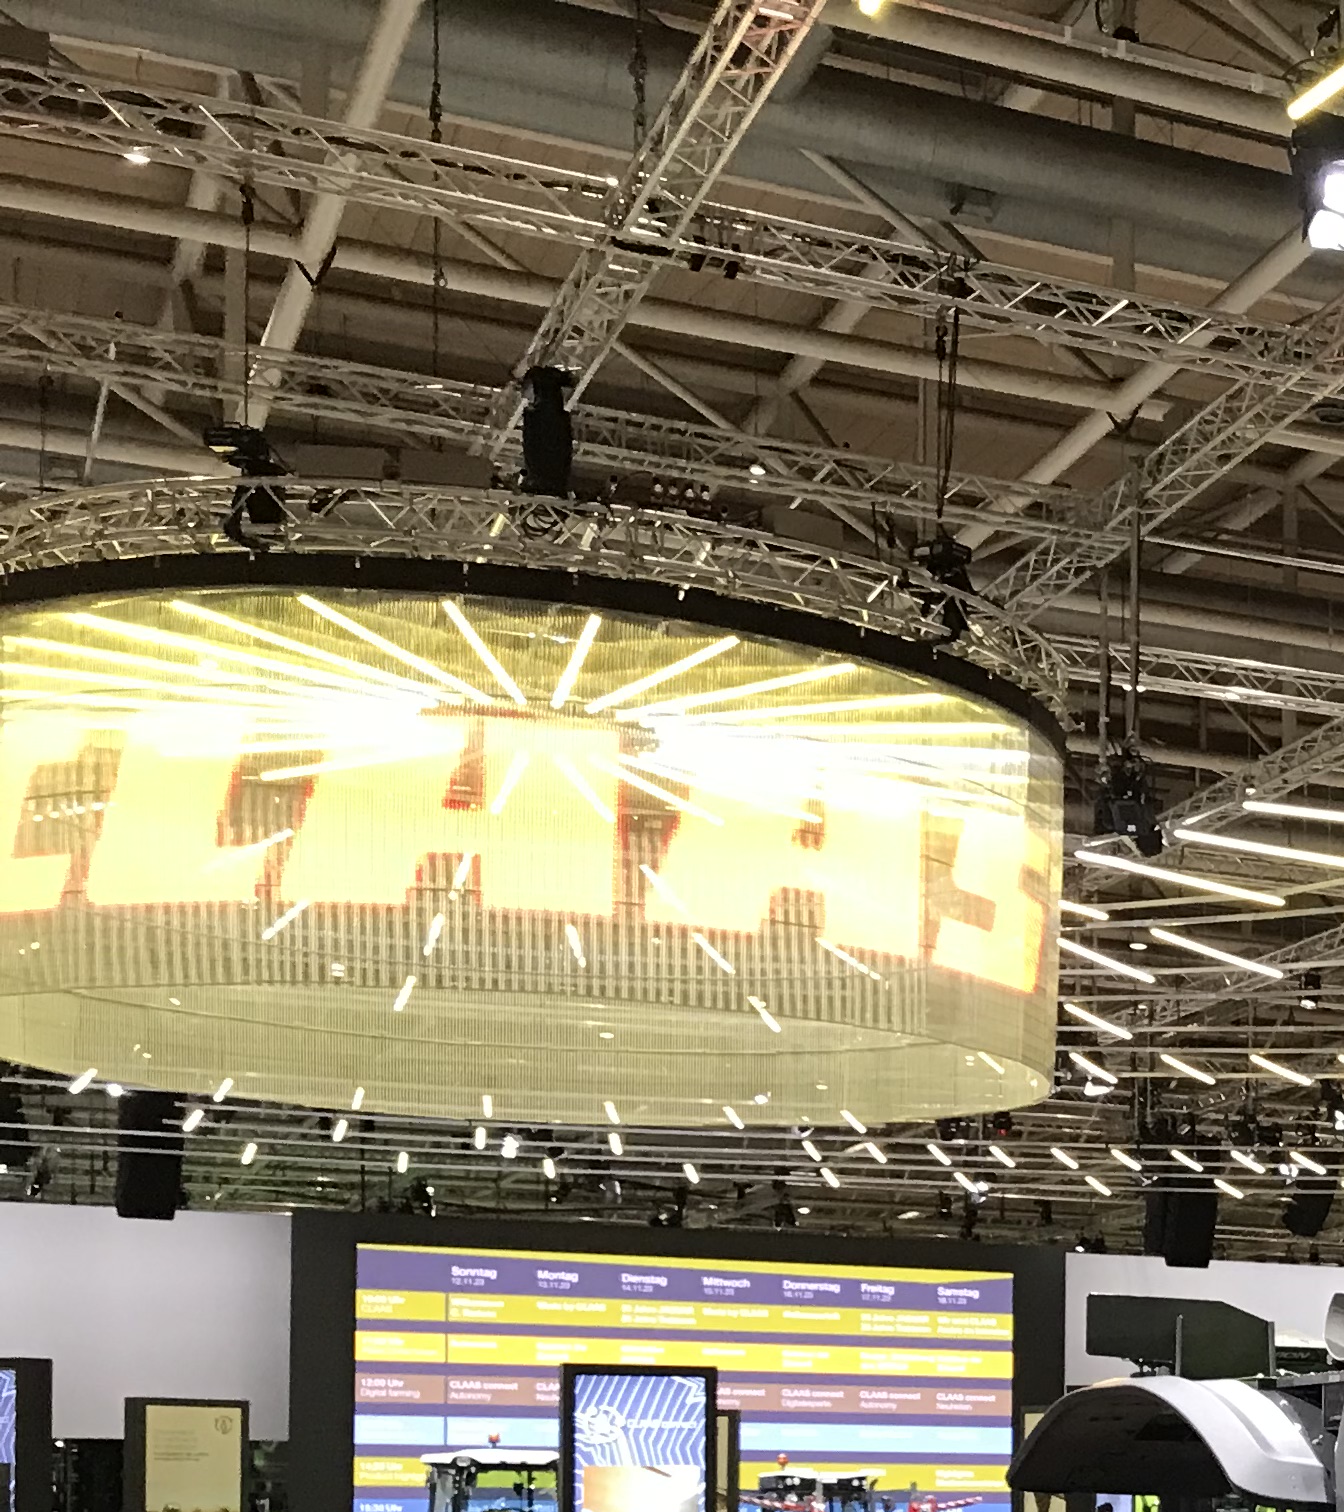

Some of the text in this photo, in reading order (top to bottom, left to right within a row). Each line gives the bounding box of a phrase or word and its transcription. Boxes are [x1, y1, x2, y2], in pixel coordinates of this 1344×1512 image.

[451, 1265, 497, 1280] Sonntag
[537, 1269, 579, 1283] Montag
[621, 1273, 668, 1287] Dienstag
[702, 1276, 751, 1288] Mittwoch
[782, 1280, 840, 1294] Donnerstag
[860, 1283, 895, 1296] Freitag
[937, 1286, 979, 1299] Samstag
[387, 1378, 404, 1388] Uhr
[449, 1380, 481, 1390] CLAAS
[782, 1388, 811, 1397] CLAAS
[859, 1390, 888, 1399] CLAAS
[936, 1392, 964, 1401] CLAAS
